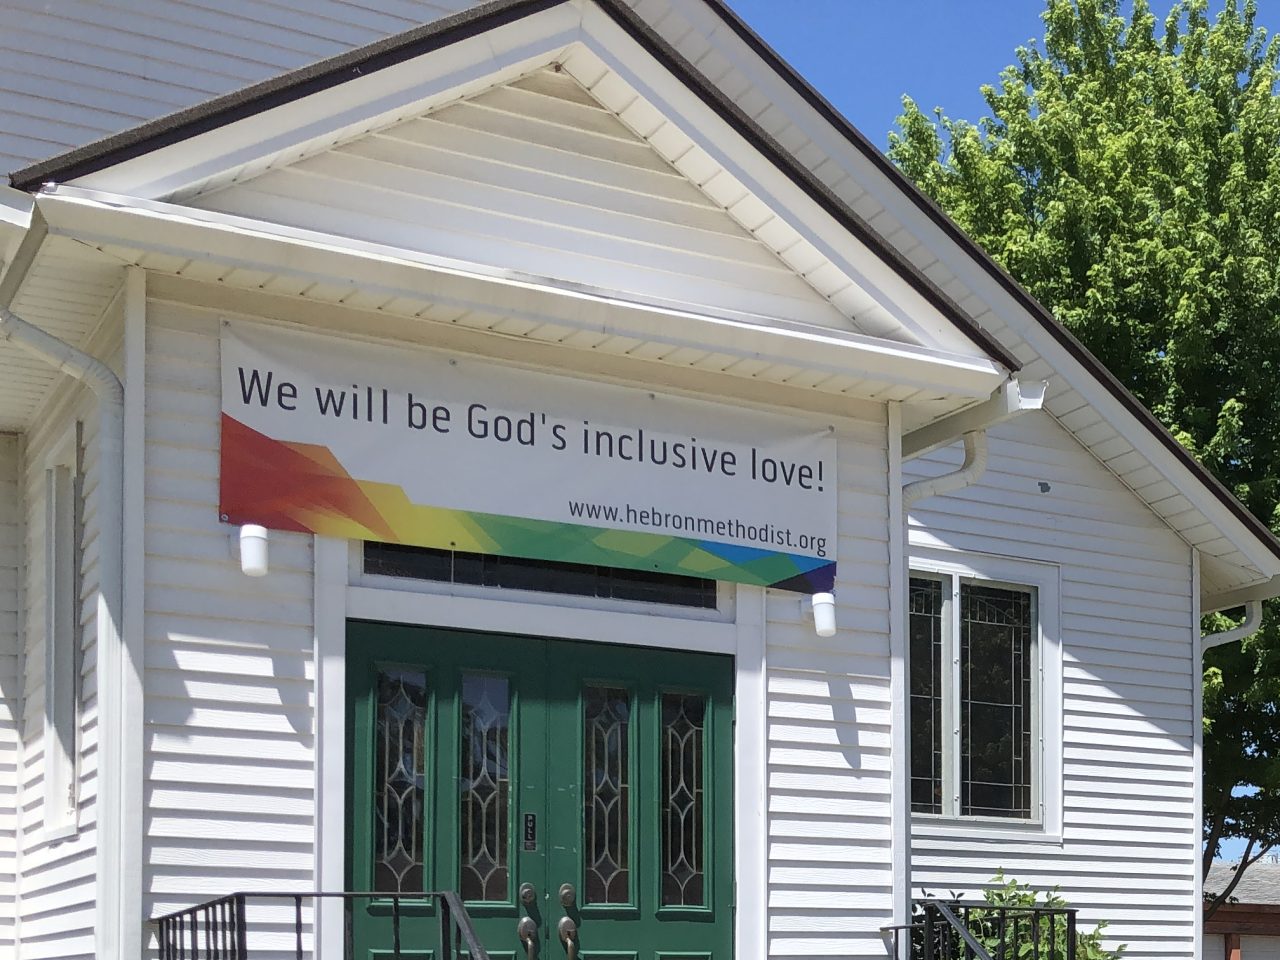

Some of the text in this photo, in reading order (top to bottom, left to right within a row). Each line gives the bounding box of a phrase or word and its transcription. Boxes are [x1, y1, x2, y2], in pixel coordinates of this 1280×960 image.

[238, 367, 824, 492] We will be God's inclusive love!
[569, 501, 827, 557] www.hebronmethodist.org
